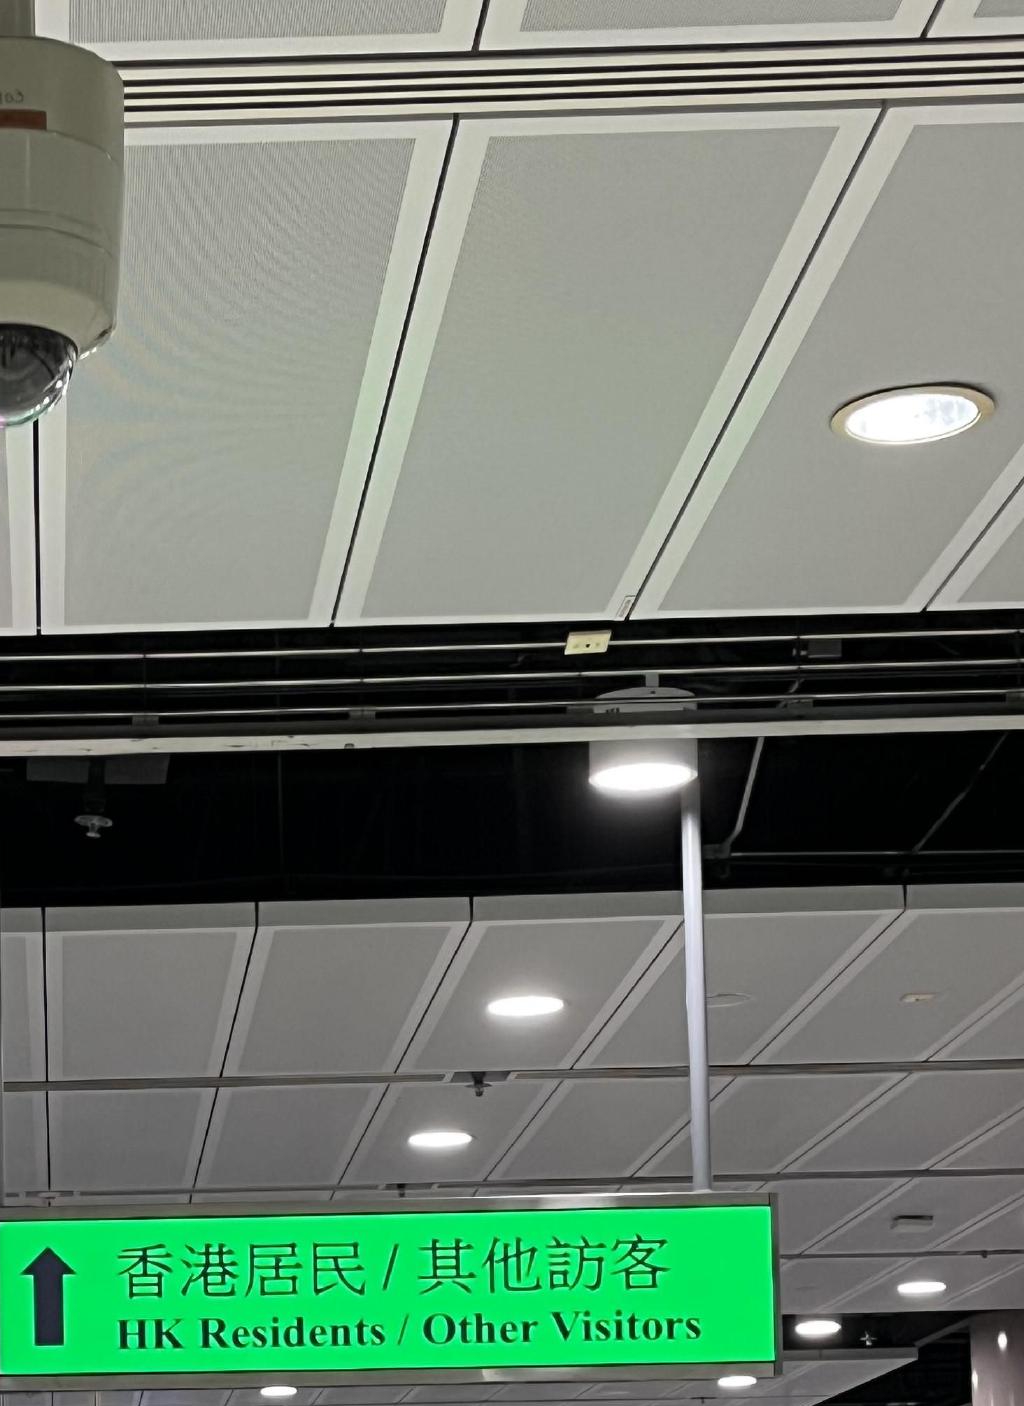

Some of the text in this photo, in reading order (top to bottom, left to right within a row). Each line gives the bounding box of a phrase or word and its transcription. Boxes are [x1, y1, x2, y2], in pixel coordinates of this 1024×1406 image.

[117, 1234, 669, 1299] 香港居民 / 其他訪客
[118, 1309, 701, 1350] HK Residents / Other Visitors
